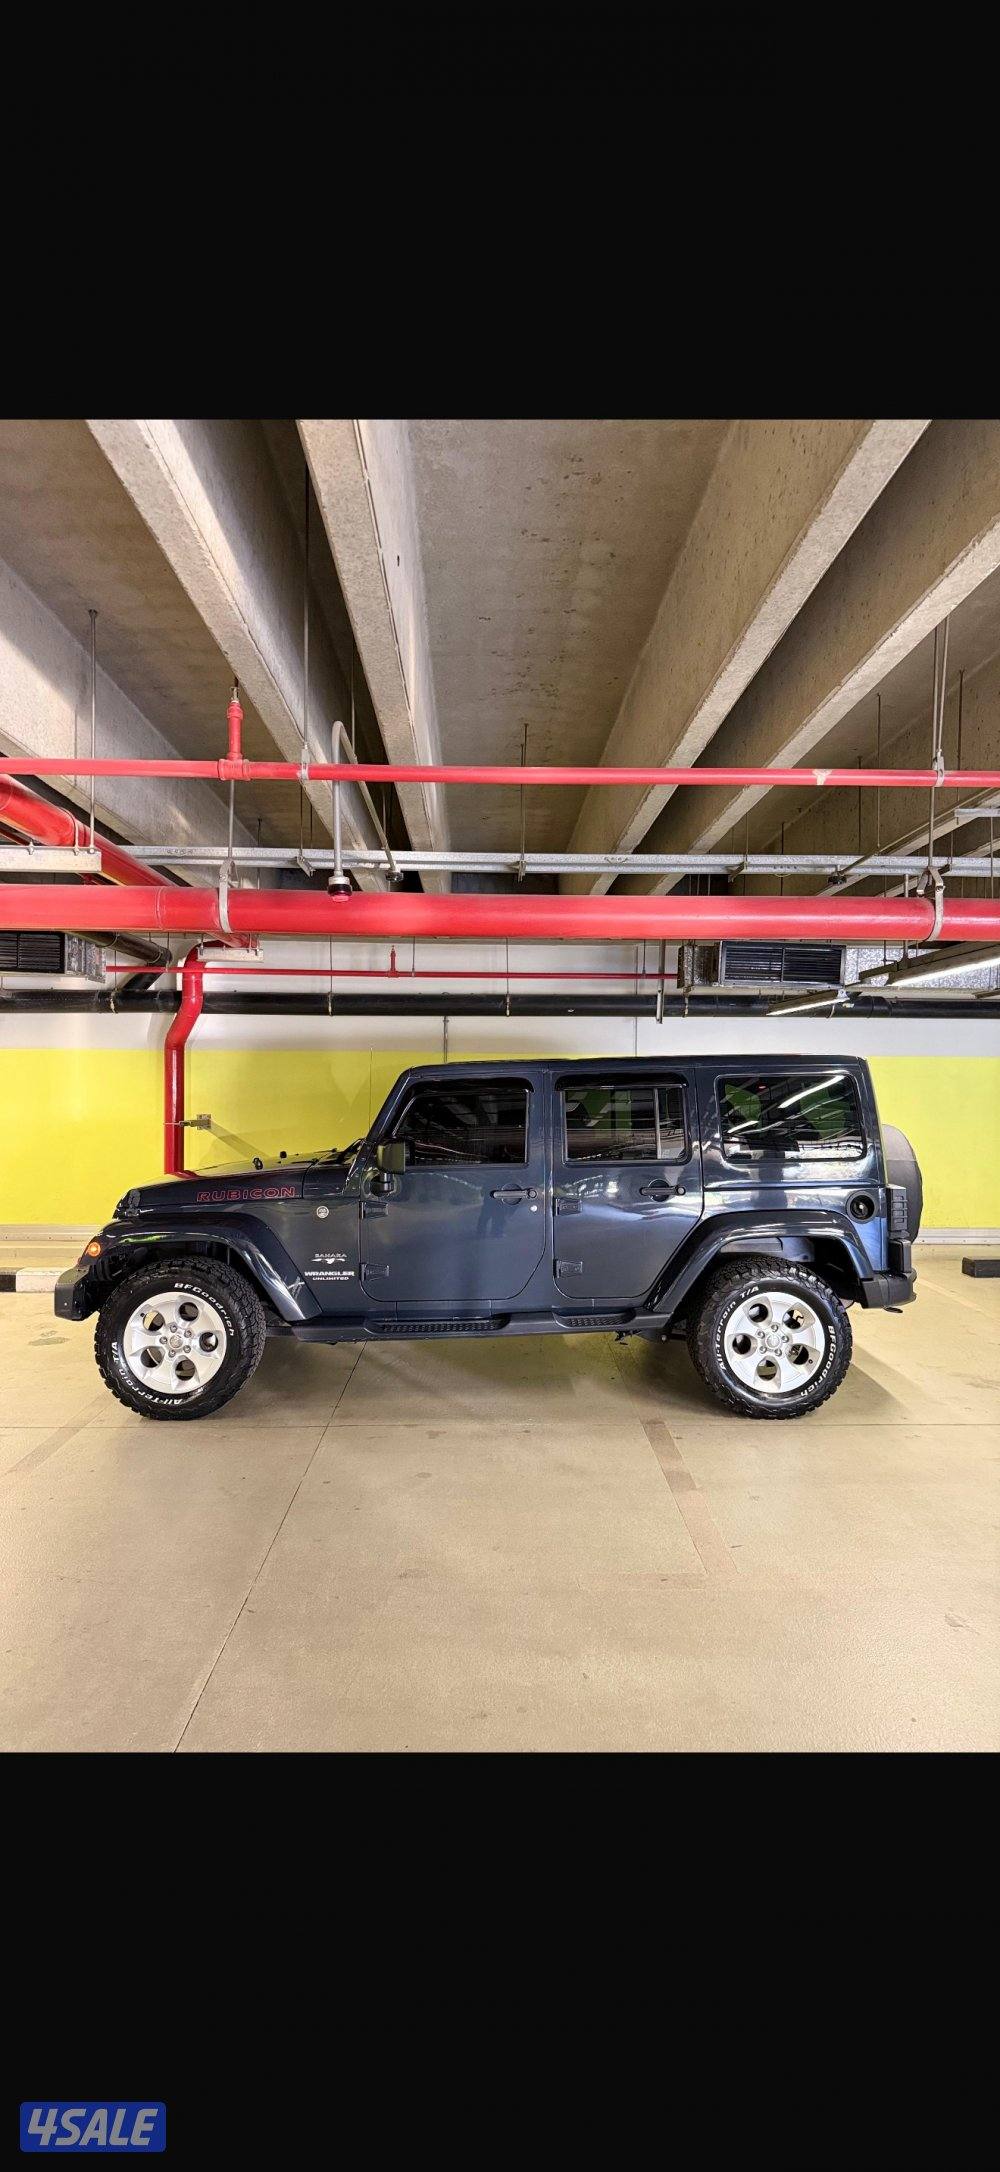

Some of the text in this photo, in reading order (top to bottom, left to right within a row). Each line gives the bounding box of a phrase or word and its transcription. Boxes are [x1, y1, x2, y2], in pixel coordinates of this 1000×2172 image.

[197, 1187, 296, 1201] RUBICON
[174, 1282, 235, 1336] BFGoodrich
[739, 1285, 760, 1299] T/A
[800, 1325, 837, 1397] BFGoodrich
